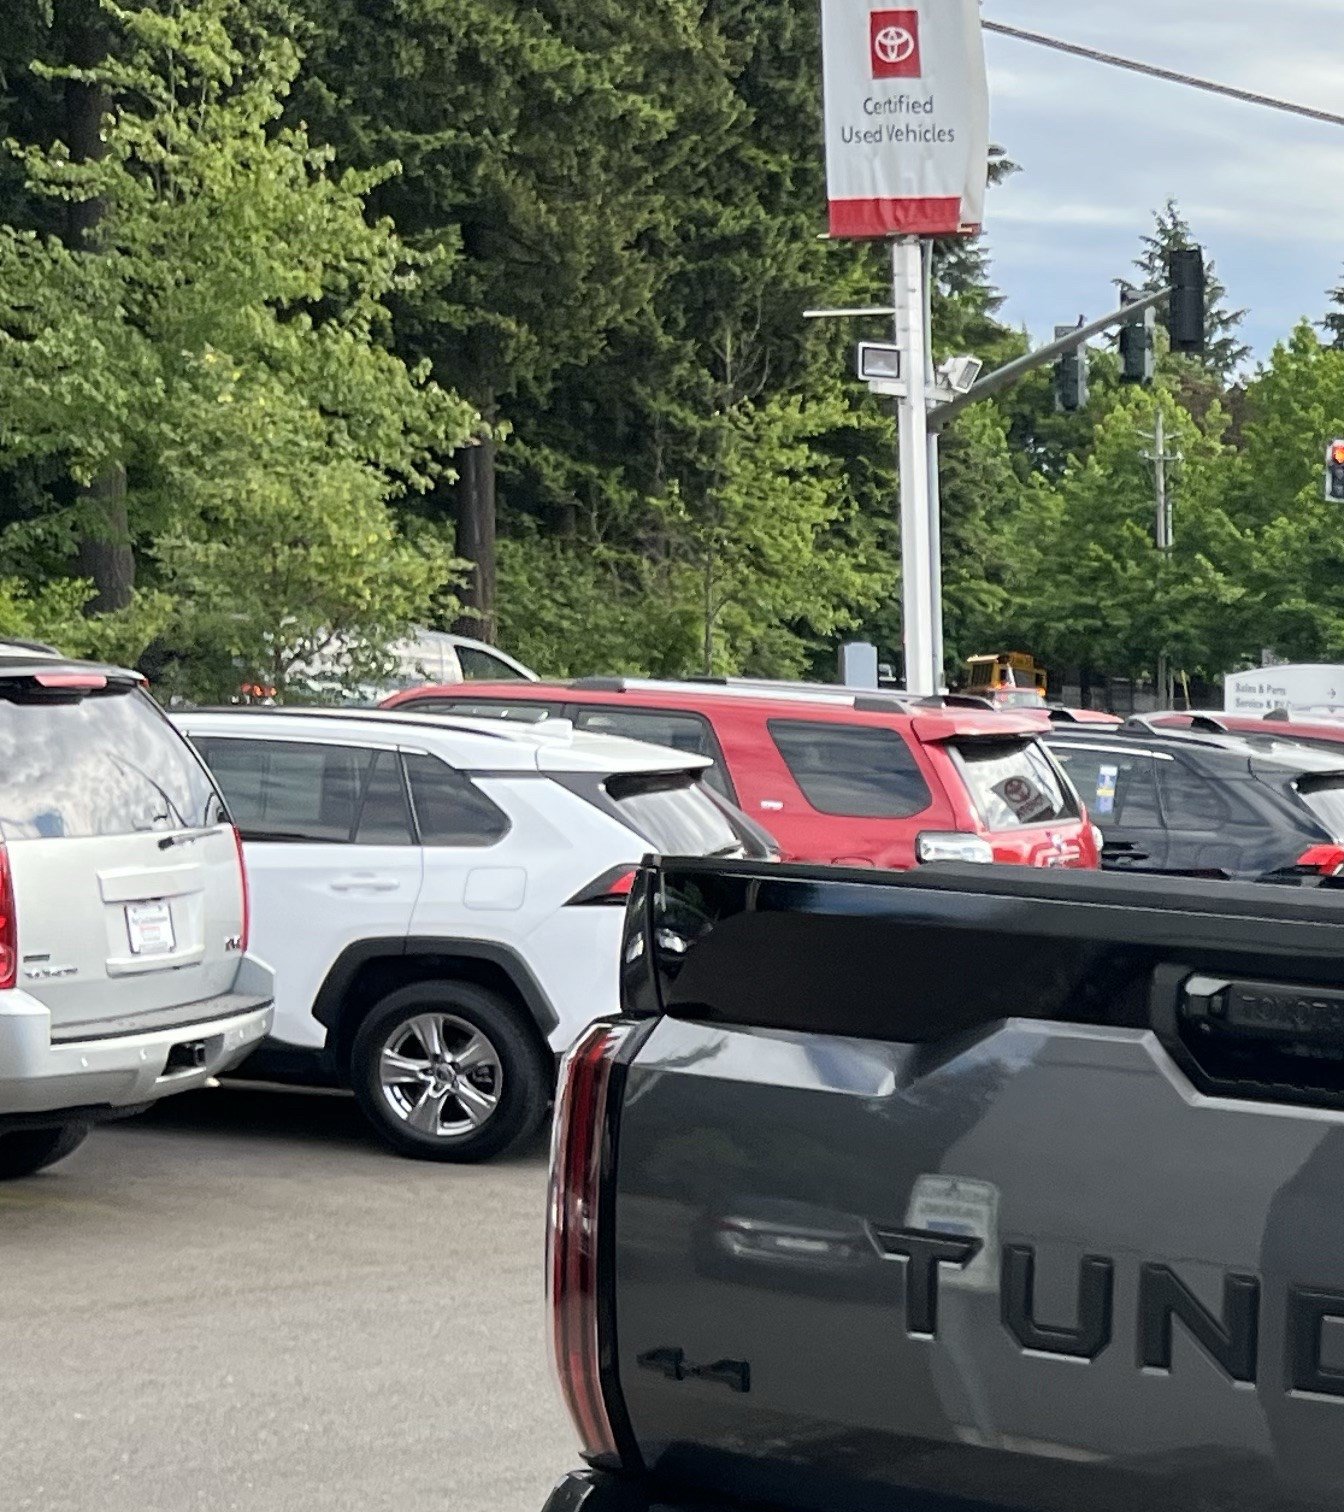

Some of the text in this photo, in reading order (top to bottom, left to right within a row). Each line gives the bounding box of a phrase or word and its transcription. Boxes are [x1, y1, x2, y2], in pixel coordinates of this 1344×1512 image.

[863, 95, 934, 115] Certified
[841, 123, 955, 144] Used Vehicles
